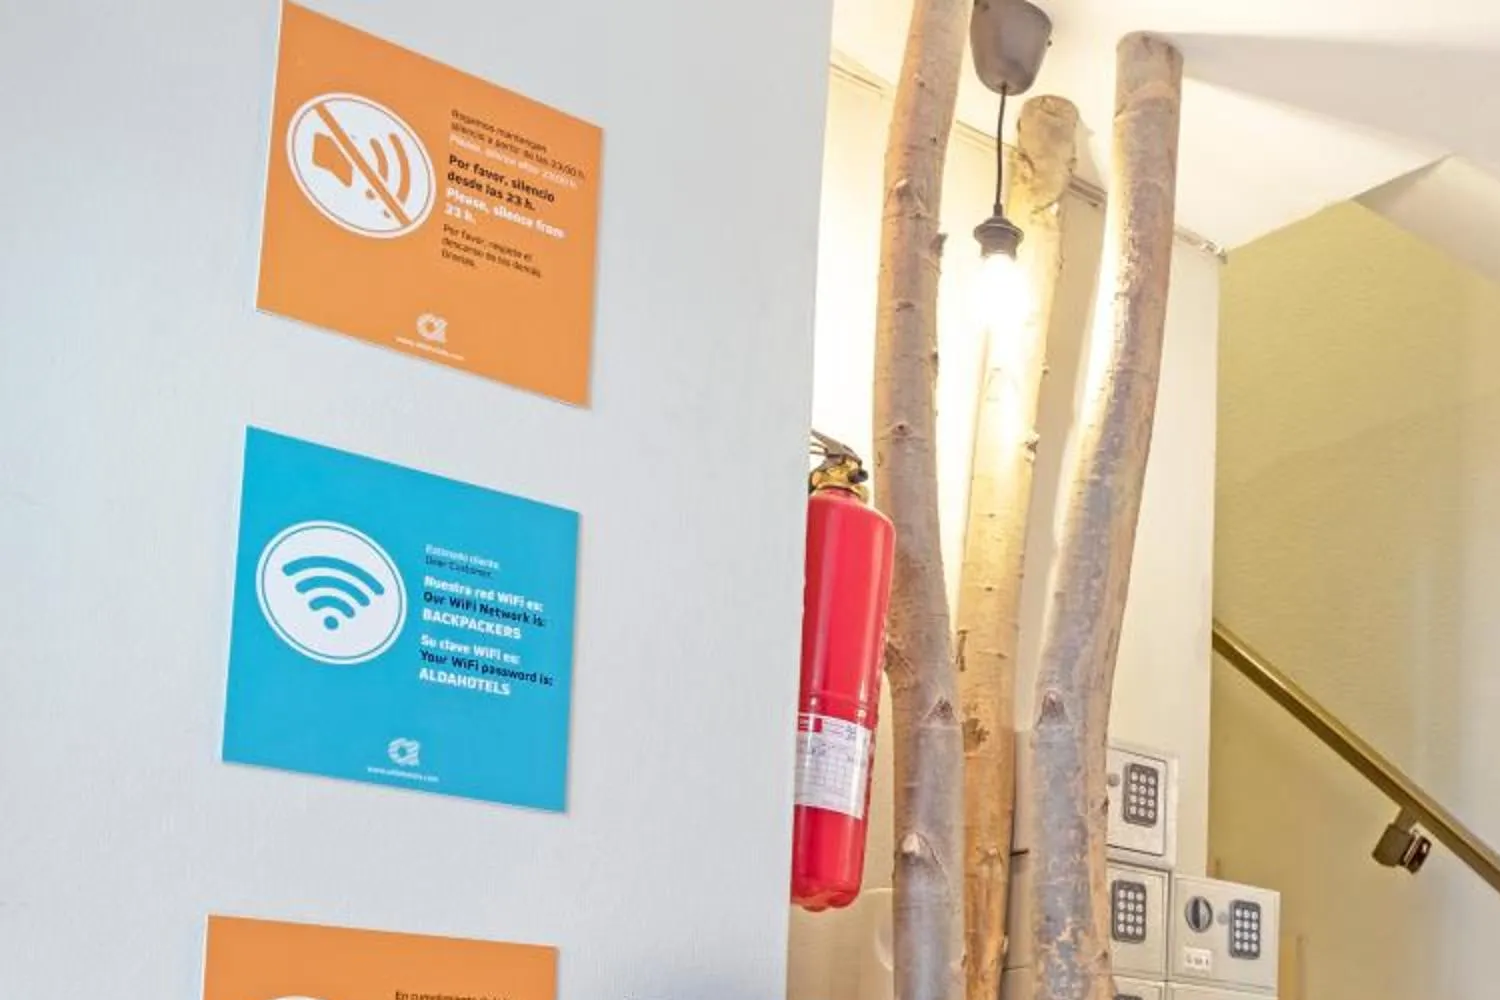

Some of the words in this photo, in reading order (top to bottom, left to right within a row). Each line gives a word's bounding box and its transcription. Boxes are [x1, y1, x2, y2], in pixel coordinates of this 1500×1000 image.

[447, 171, 483, 192] desde
[485, 184, 503, 200] las
[506, 191, 523, 206] 23
[448, 153, 470, 170] Por
[473, 163, 509, 187] favor,
[511, 178, 555, 203] silencio
[423, 575, 471, 596] Nuestra
[474, 587, 495, 601] red
[498, 591, 525, 606] WiFi
[423, 591, 446, 605] Our
[449, 595, 477, 609] WiFi
[480, 602, 529, 625] Network
[423, 607, 522, 640] BACKPACKERS
[420, 634, 437, 648] Su
[439, 639, 471, 655] clave
[473, 644, 502, 660] WiFi
[419, 667, 511, 696] ALDAHOTELS
[420, 650, 447, 665] Your
[451, 655, 479, 672] WiFi
[481, 663, 537, 684] password
[539, 673, 554, 687] is:
